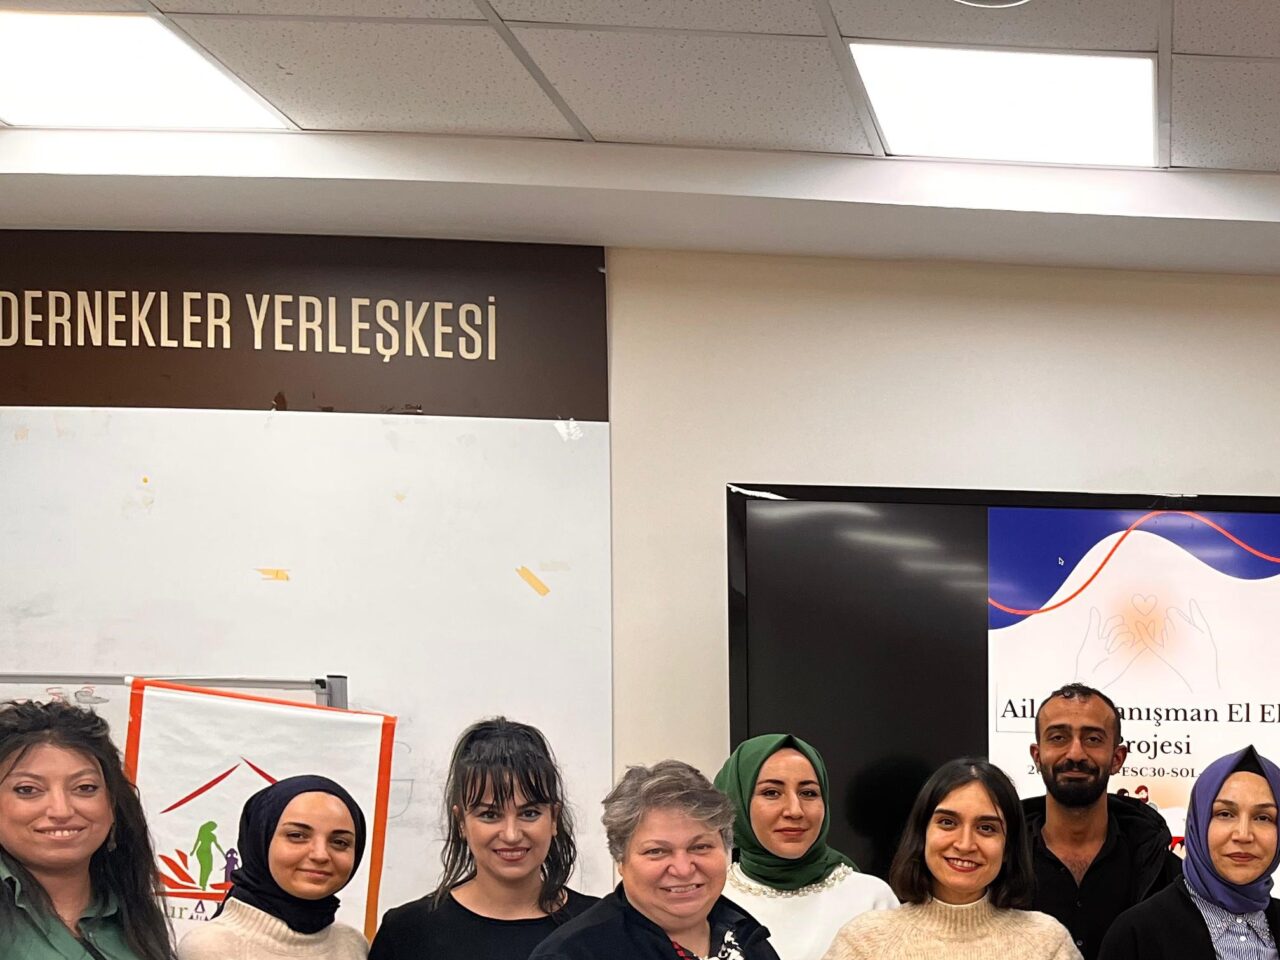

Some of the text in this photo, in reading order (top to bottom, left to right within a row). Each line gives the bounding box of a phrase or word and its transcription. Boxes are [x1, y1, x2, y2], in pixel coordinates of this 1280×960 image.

[0, 290, 497, 362] DERNEKLER YERLEŞKESİ
[1001, 698, 1036, 719] Ail
[1116, 705, 1219, 727] anışman
[1228, 703, 1251, 723] El
[1120, 734, 1192, 760] rojesi
